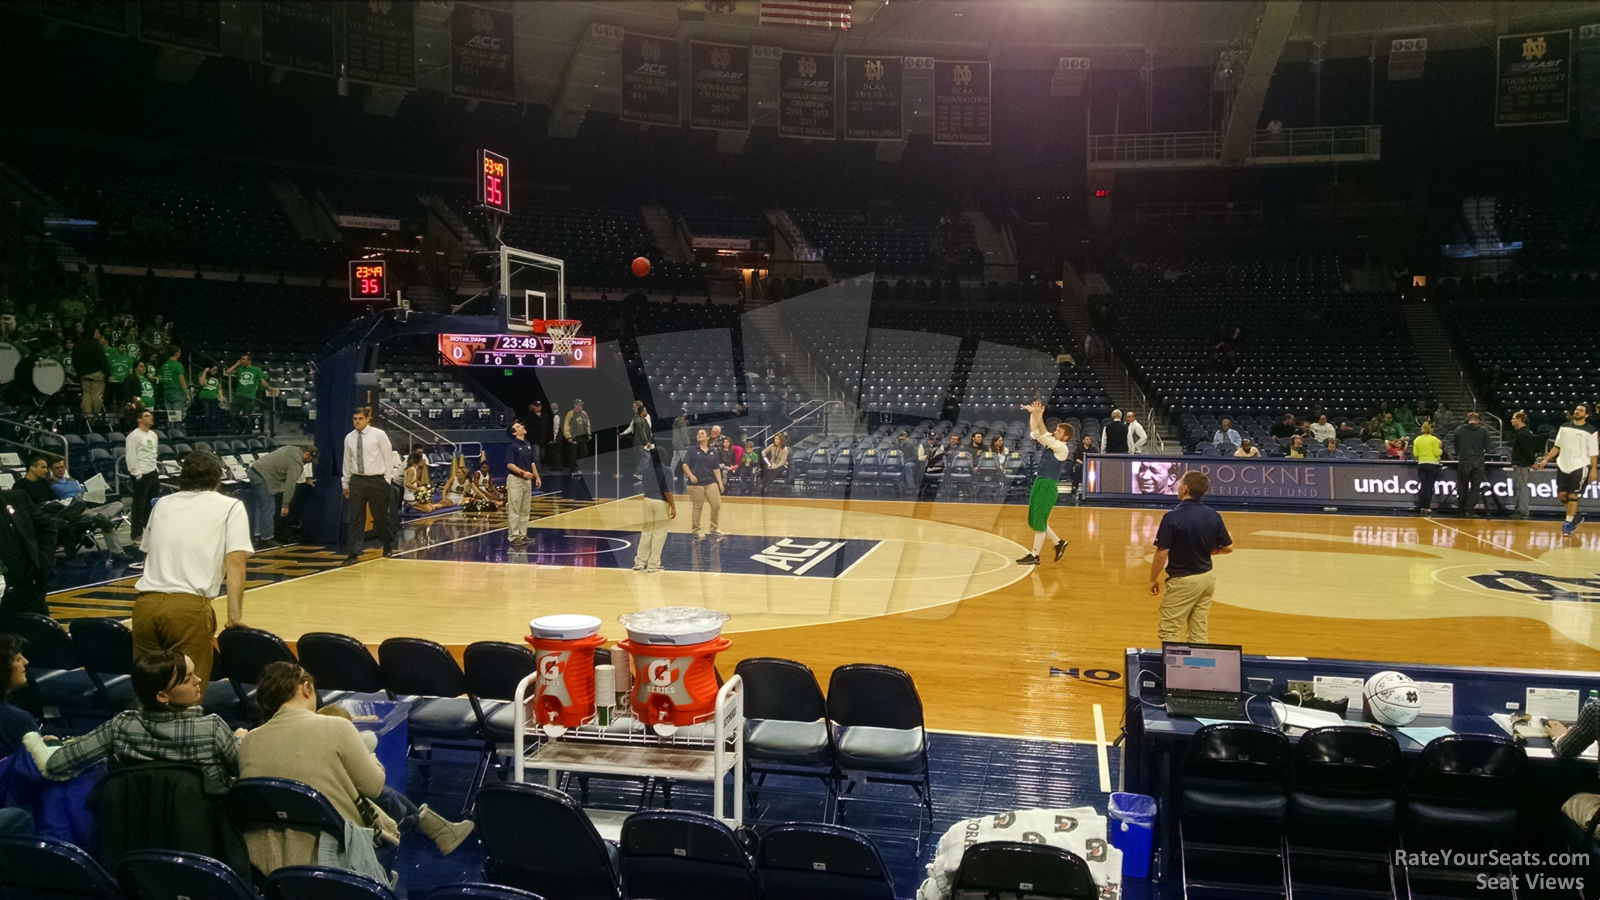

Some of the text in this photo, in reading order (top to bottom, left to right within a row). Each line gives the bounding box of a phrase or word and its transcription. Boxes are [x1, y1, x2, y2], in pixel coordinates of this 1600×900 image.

[465, 35, 501, 49] ACC
[635, 63, 668, 74] ACC
[1502, 73, 1566, 86] TOURNAMENT
[1508, 83, 1557, 93] CHAMPION
[484, 157, 504, 177] 23:49
[487, 175, 501, 205] 35
[356, 266, 382, 278] 23:49
[361, 279, 379, 293] 35
[502, 337, 537, 349] 23:49
[453, 347, 463, 359] 0
[574, 348, 583, 360] 0
[495, 357, 502, 365] 0
[537, 358, 544, 366] 0
[1200, 465, 1317, 485] ROCKNE
[1206, 486, 1318, 497] ERITAGE FUND
[750, 537, 832, 572] ACC
[540, 654, 560, 679] G
[648, 658, 671, 685] G
[539, 679, 560, 687] SERIES
[646, 685, 675, 694] SERIES
